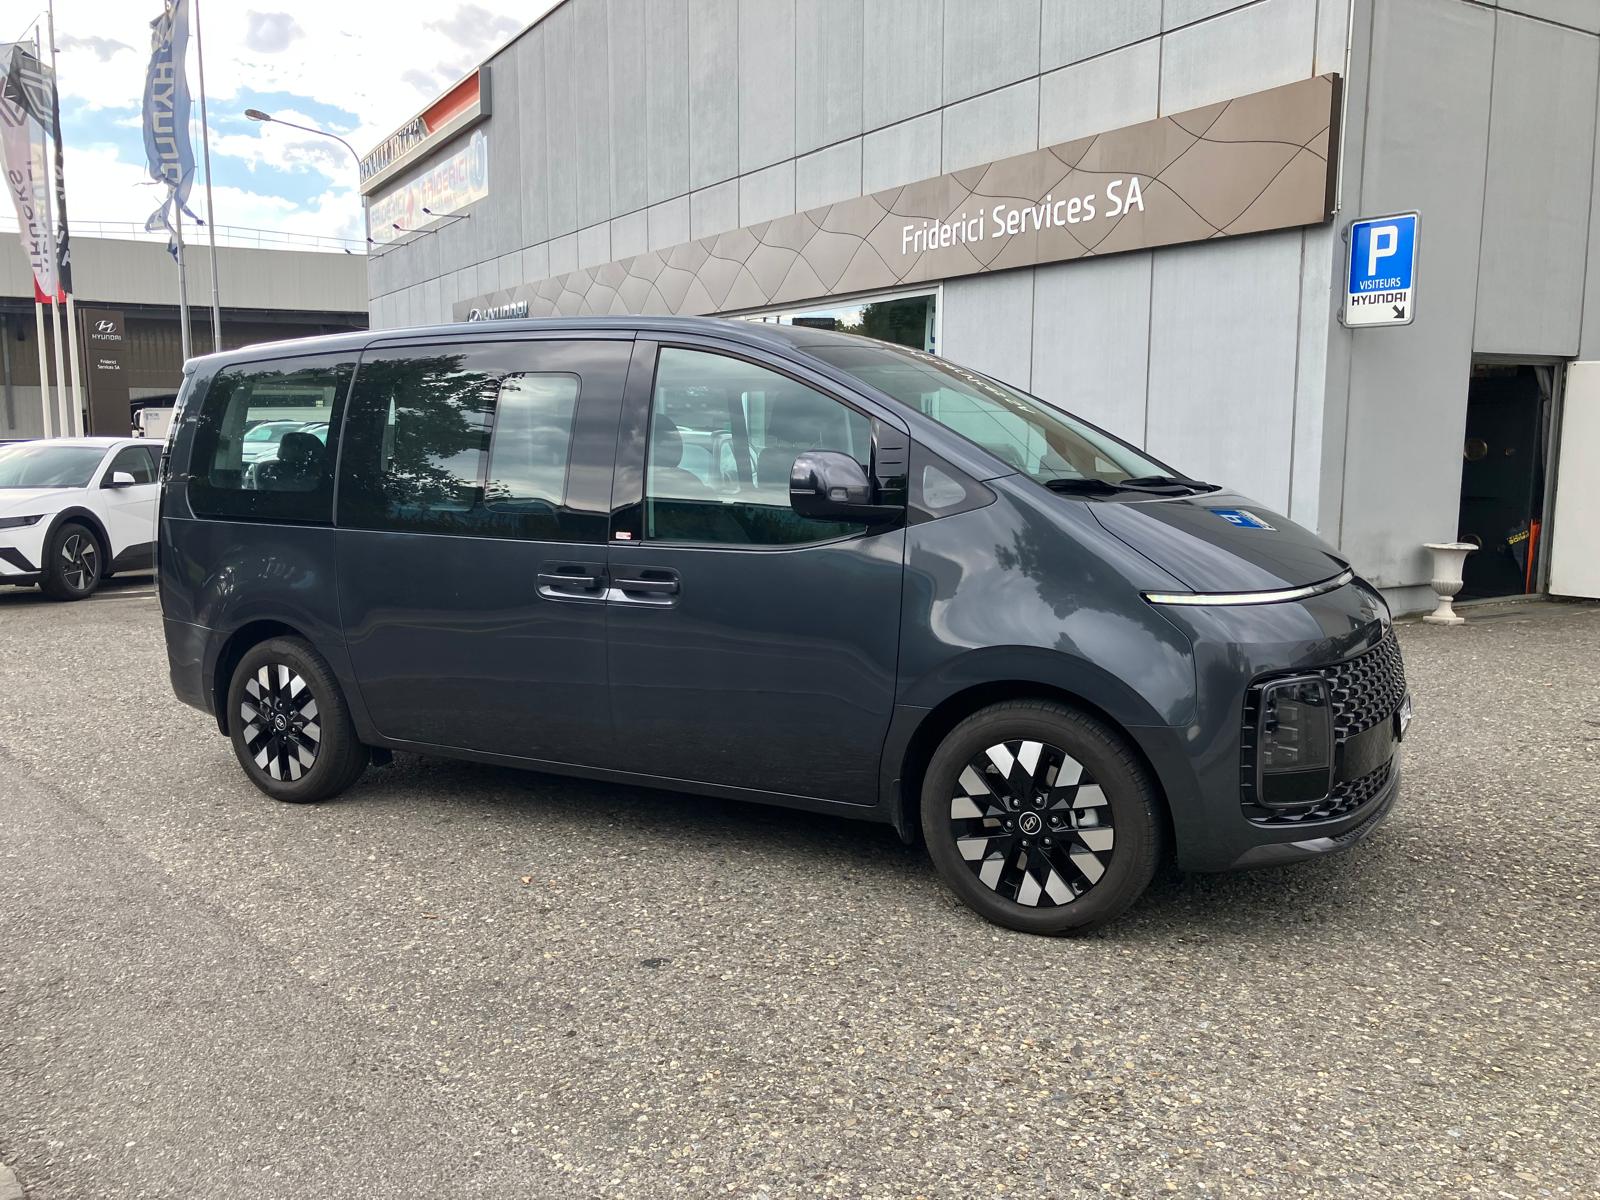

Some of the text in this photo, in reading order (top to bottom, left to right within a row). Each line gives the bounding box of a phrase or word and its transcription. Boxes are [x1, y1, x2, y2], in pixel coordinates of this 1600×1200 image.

[901, 176, 1145, 256] Friderici Services SA
[1367, 225, 1399, 276] P
[1359, 277, 1401, 290] VISITEURS
[1351, 291, 1407, 306] HYUNDAI
[91, 333, 121, 341] HYUNDAI
